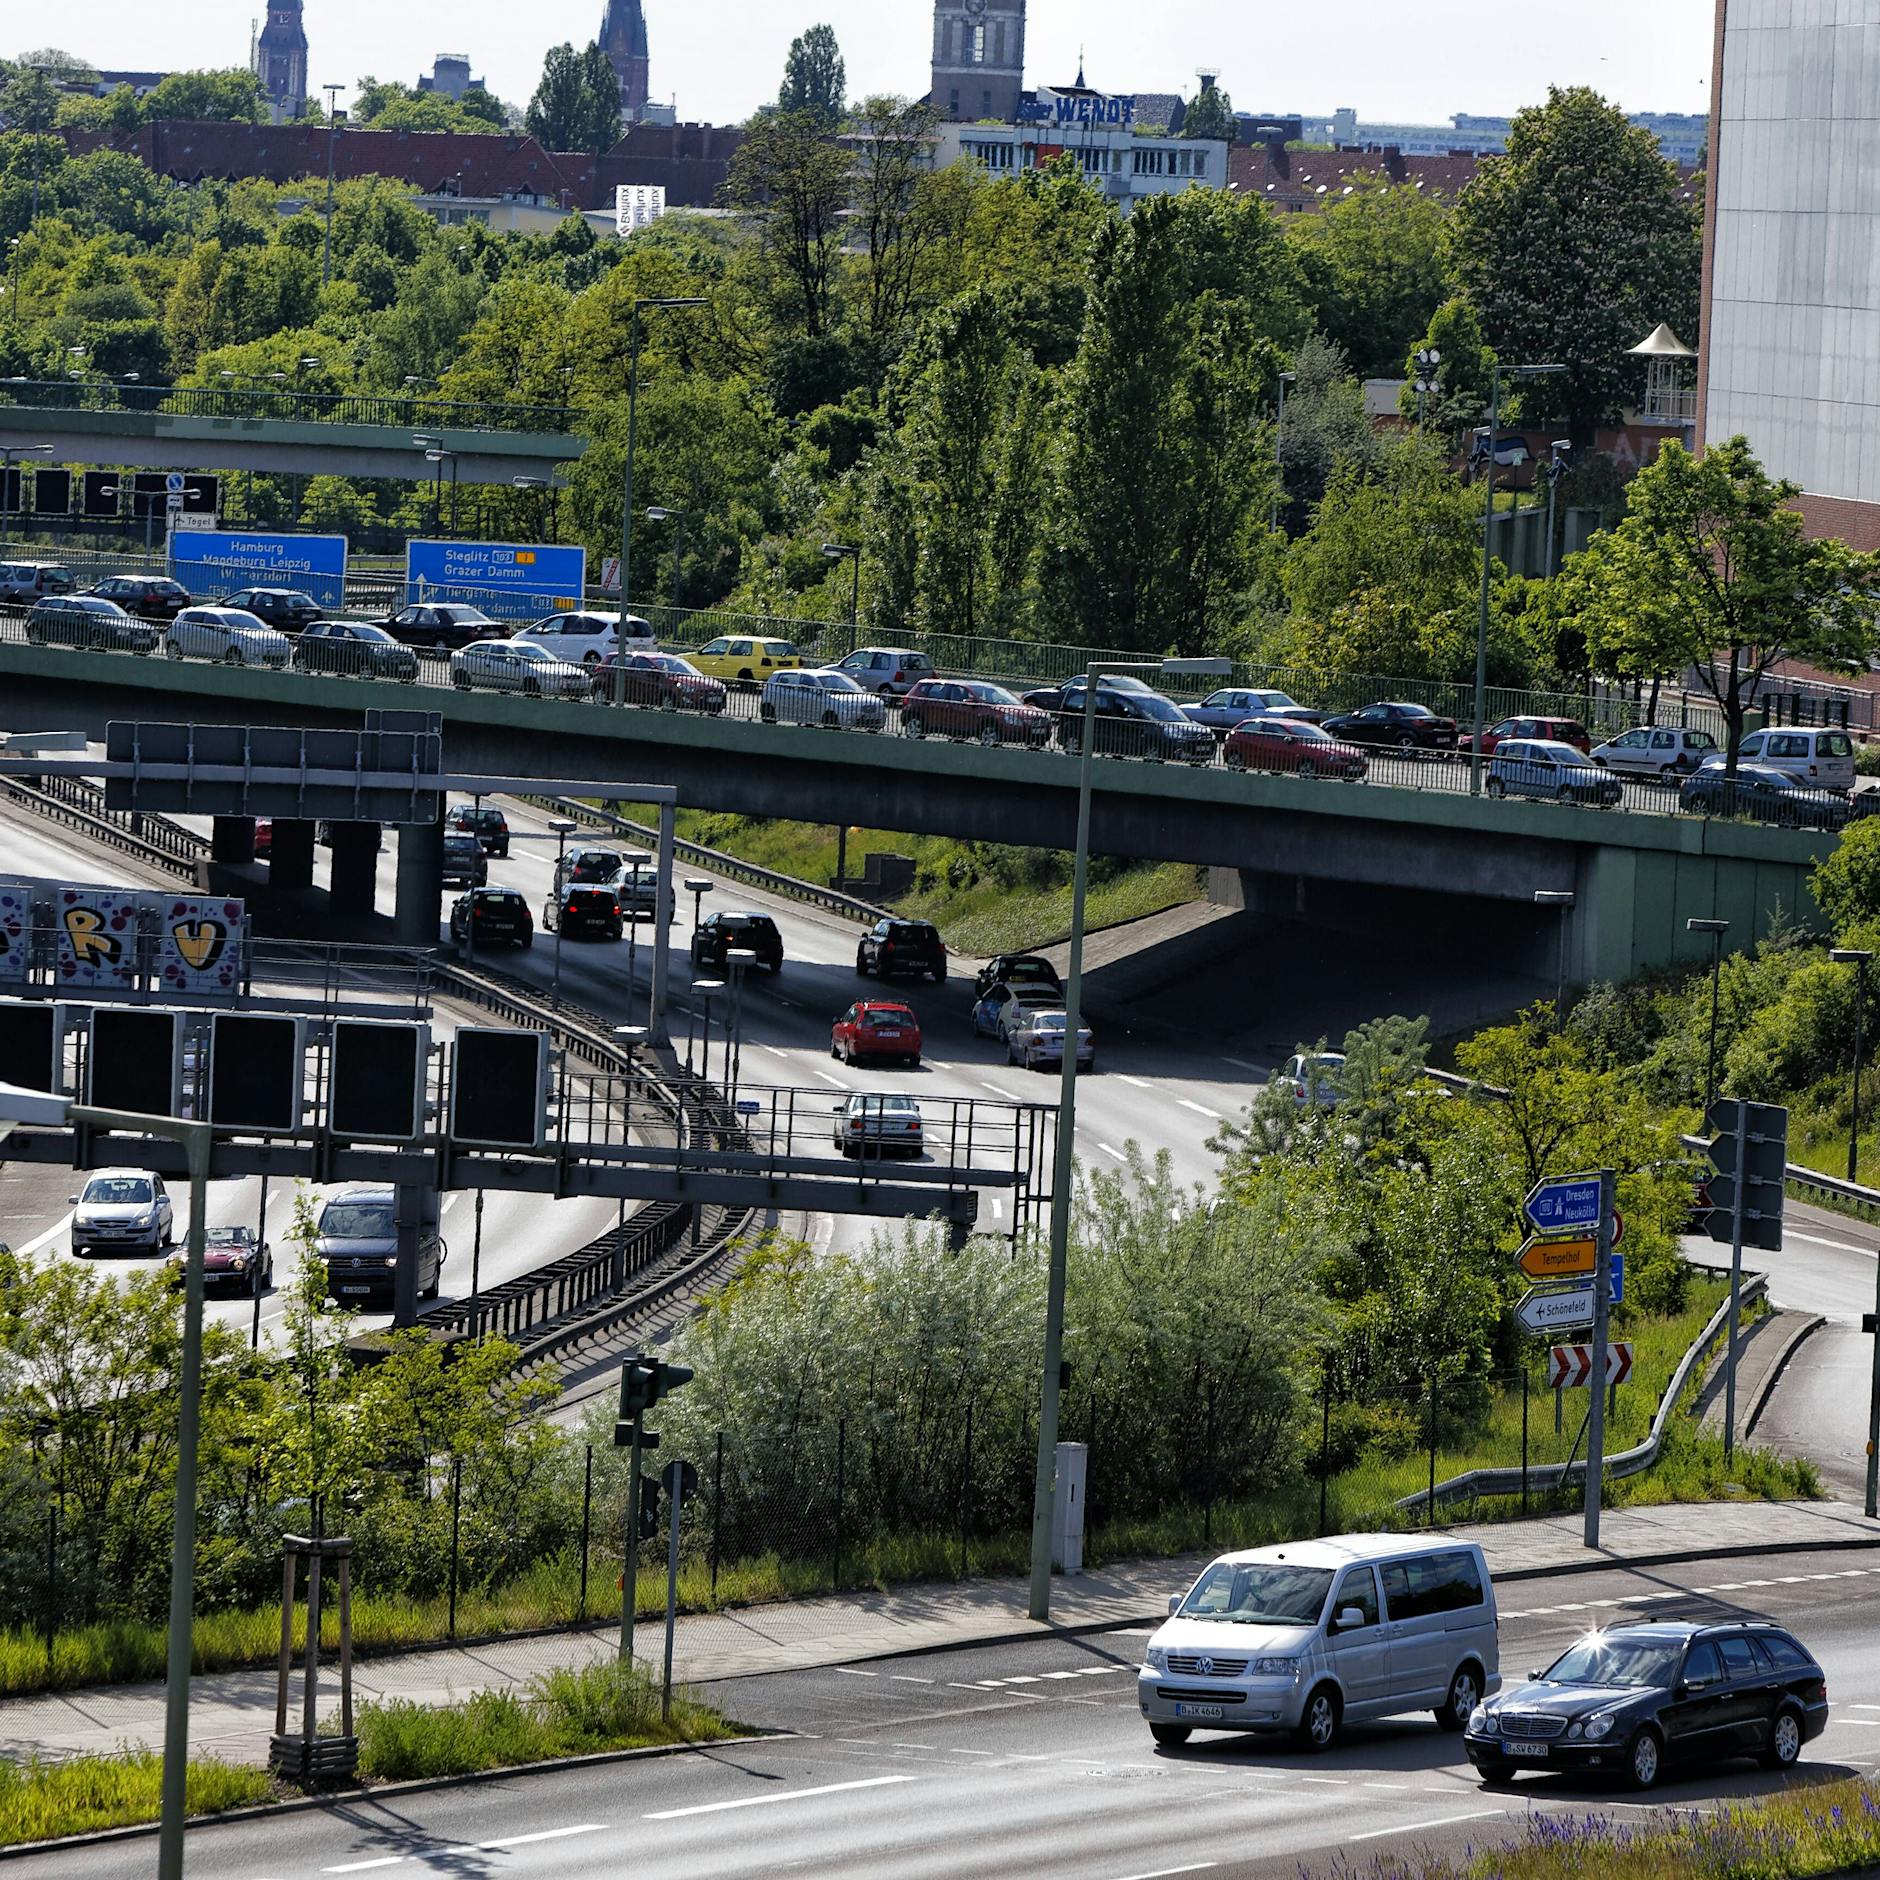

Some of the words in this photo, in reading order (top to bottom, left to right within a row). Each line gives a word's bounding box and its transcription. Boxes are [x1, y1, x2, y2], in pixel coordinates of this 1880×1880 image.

[1056, 97, 1136, 123] WENDT
[188, 516, 211, 527] Tegel
[231, 541, 284, 555] Hamburg
[270, 556, 311, 571] Leipzig
[445, 550, 489, 563] Steglitz
[495, 552, 510, 561] 103
[444, 564, 483, 577] Grazer
[488, 566, 525, 578] Damm
[63, 906, 122, 968] R
[1566, 1188, 1594, 1201] Dresden
[1565, 1205, 1596, 1220] Neukölln
[1542, 1251, 1580, 1266] Tempelhof
[1546, 1300, 1586, 1316] Schönefeld
